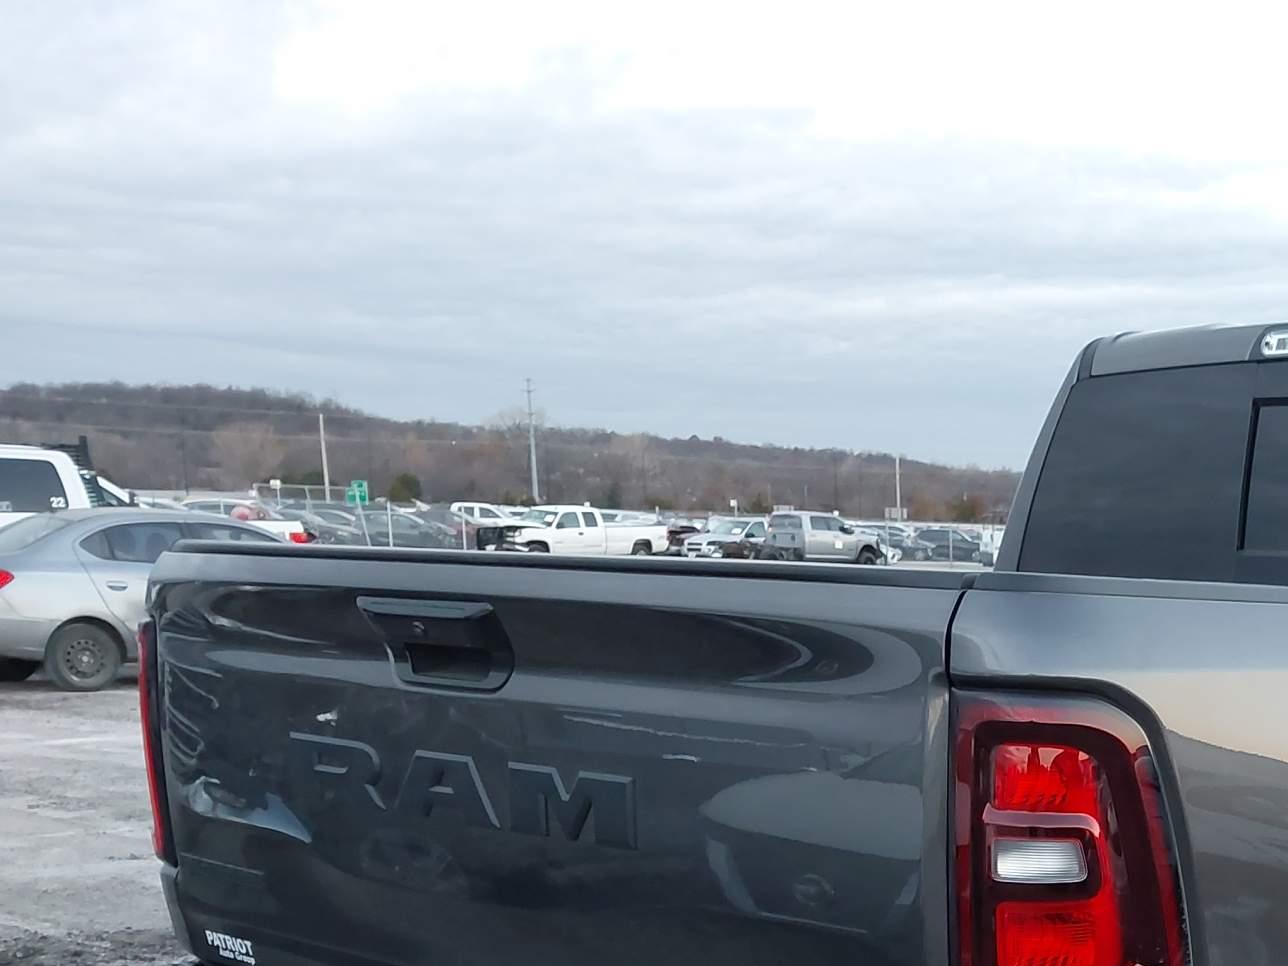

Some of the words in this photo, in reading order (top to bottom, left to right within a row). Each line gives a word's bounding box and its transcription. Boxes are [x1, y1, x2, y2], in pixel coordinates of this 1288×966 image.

[49, 496, 67, 508] 22
[288, 731, 639, 850] RAM
[205, 930, 254, 956] PATRIOT
